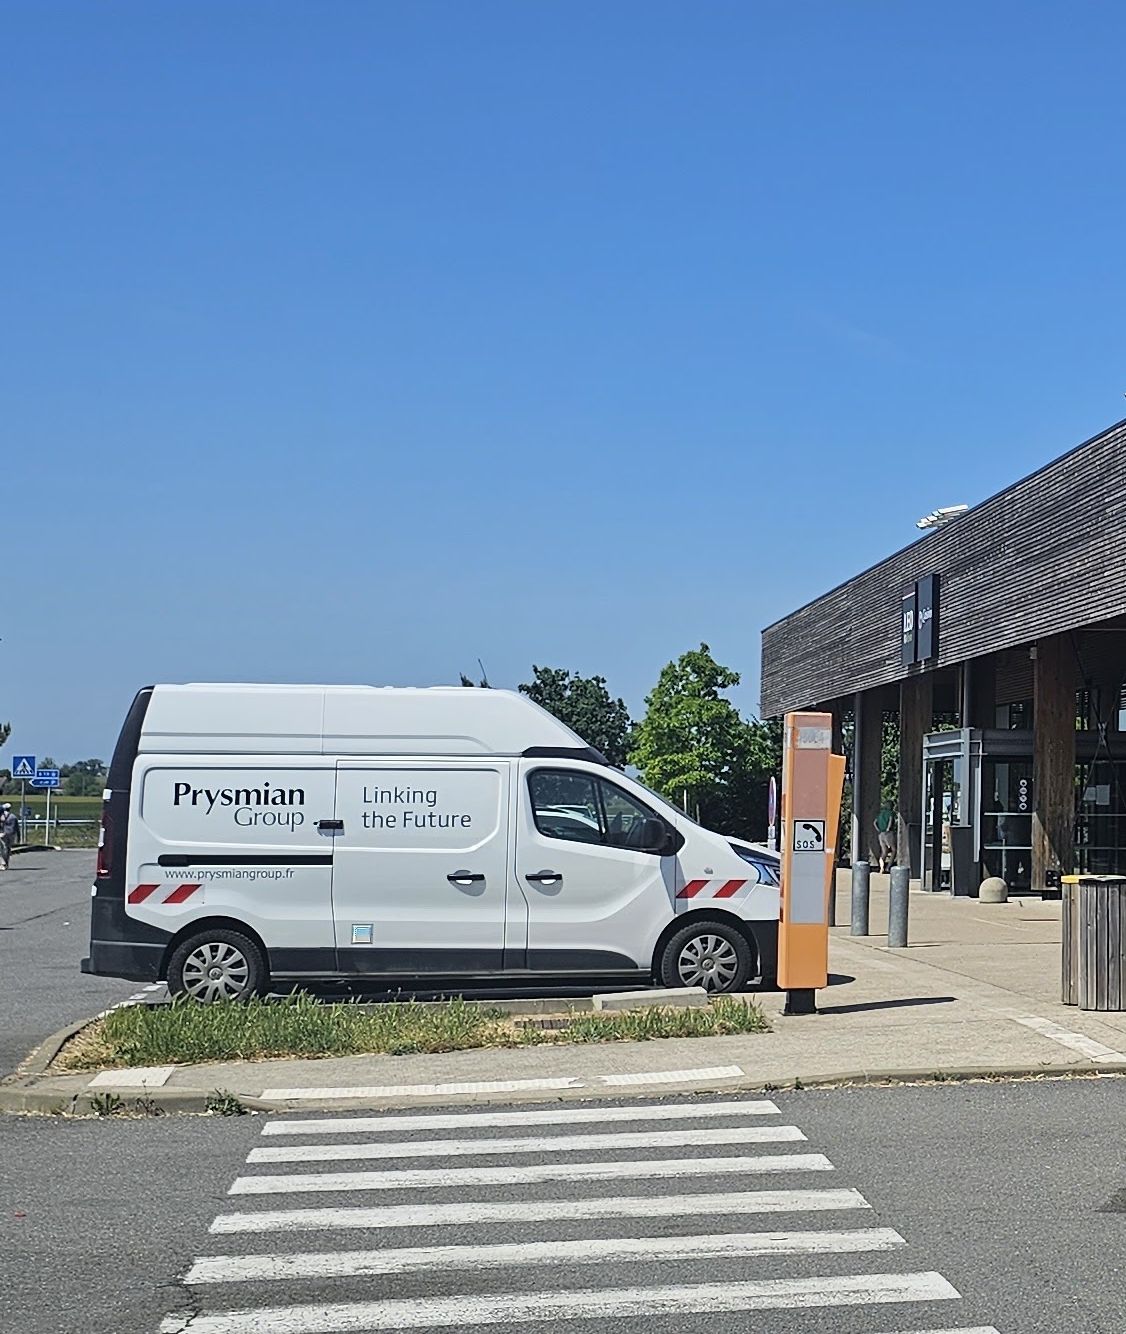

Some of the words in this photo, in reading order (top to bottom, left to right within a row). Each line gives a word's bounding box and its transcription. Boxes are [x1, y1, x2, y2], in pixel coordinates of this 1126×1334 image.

[173, 782, 305, 815] Prysmian
[363, 786, 438, 807] Linking
[234, 807, 305, 833] Group
[362, 811, 398, 829] the
[403, 811, 472, 829] Future
[796, 840, 815, 849] SOS
[165, 868, 295, 882] www.prysmiangroup.fr
